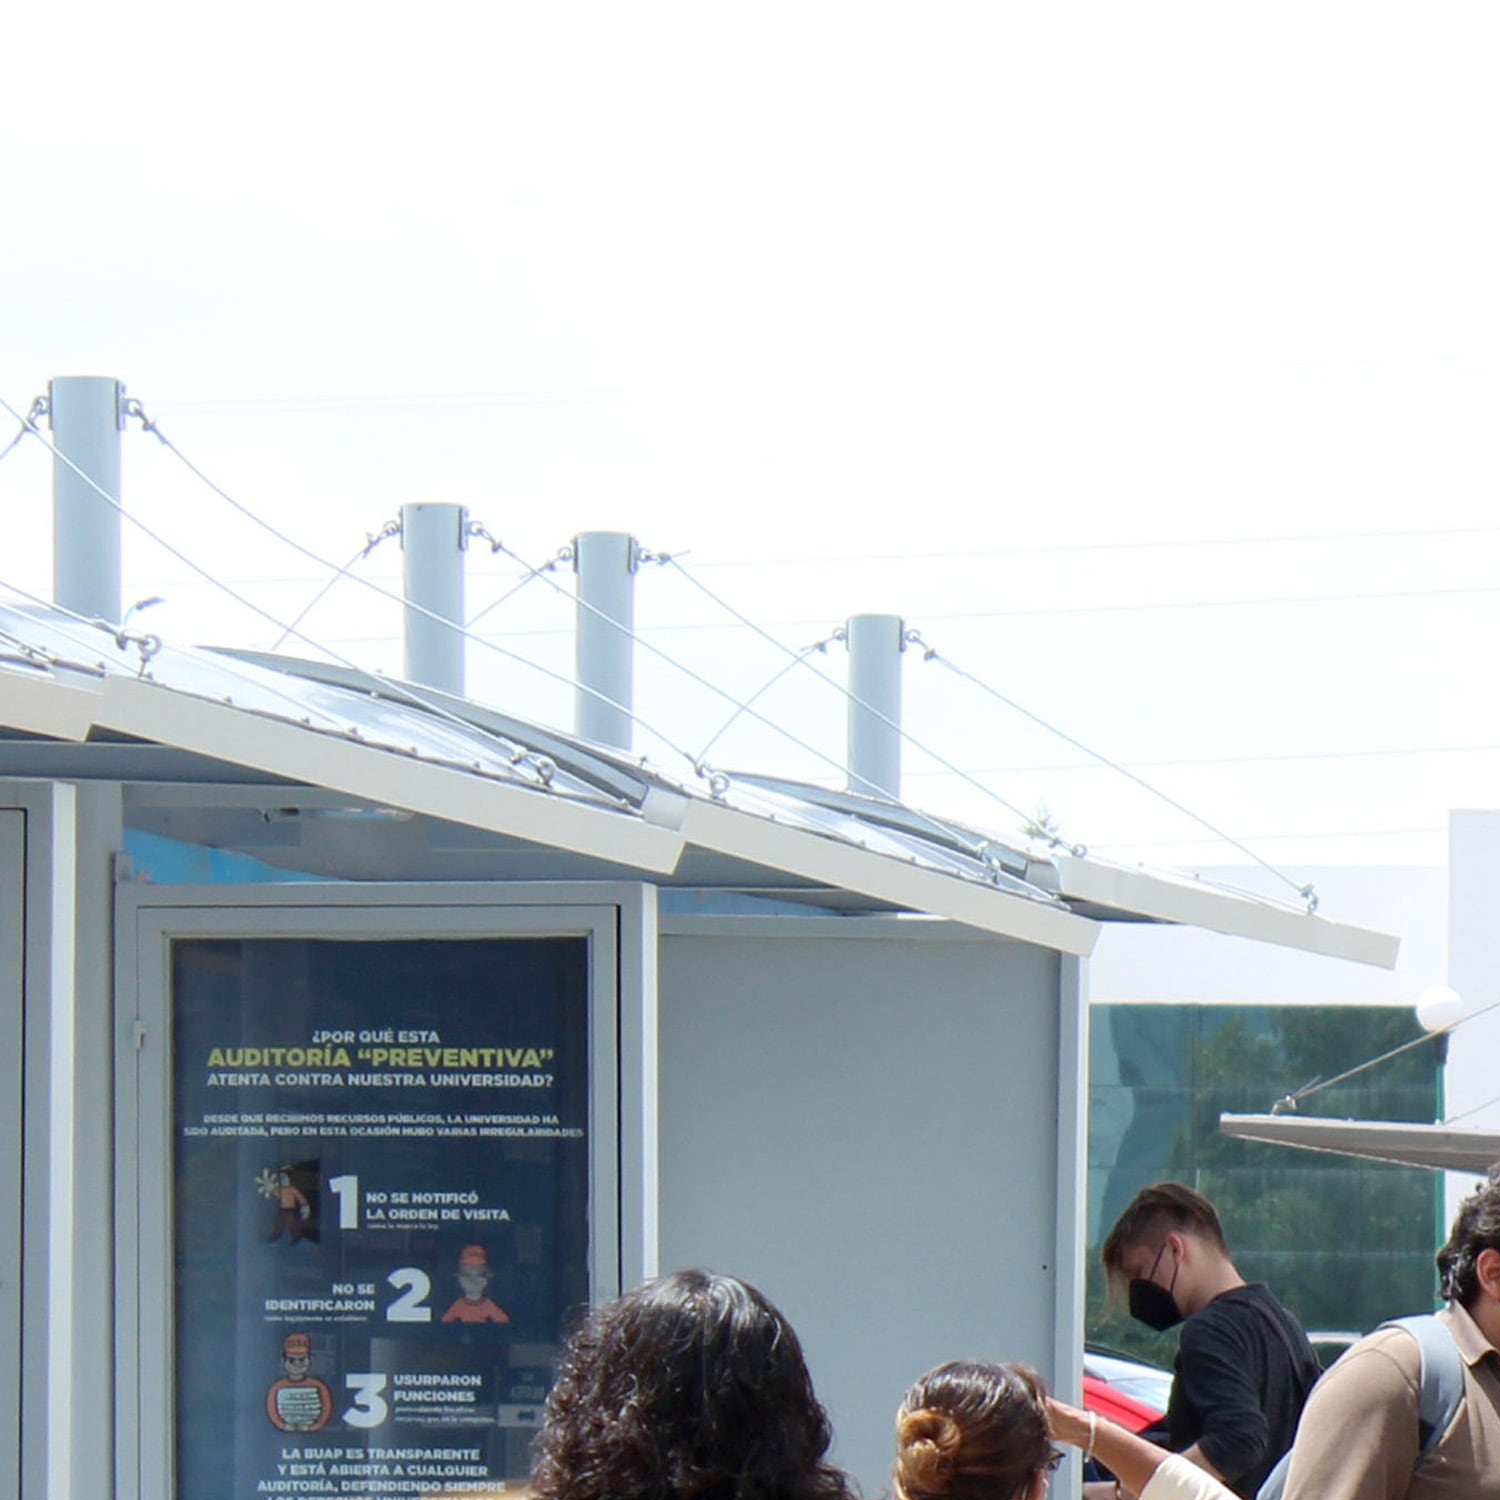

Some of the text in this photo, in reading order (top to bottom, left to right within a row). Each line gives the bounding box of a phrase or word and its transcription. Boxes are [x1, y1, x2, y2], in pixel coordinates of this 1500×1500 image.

[312, 1027, 441, 1043] ¿POR QUÉ ESTA
[207, 1043, 554, 1067] AUDITORÍA “PREVENTIVA”
[207, 1073, 553, 1087] ATENTA CONTRA NUESTRA UNIVERSIDAD?
[203, 1114, 239, 1124] DESDE
[327, 1114, 386, 1124] RECURSOS
[447, 1114, 463, 1124] LA
[464, 1115, 540, 1125] UNIVERSIDAD
[210, 1126, 268, 1137] AUDITADA,
[270, 1126, 300, 1136] PERO
[302, 1127, 317, 1136] EN
[319, 1127, 348, 1136] ESTA
[350, 1125, 400, 1136] OCASIÓN
[436, 1127, 477, 1137] VARIAS
[328, 1175, 358, 1230] 1
[366, 1189, 479, 1204] NO SE NOTIFICÓ
[366, 1209, 510, 1220] LA ORDEN DE VISITA
[332, 1283, 376, 1295] NO SE
[386, 1267, 432, 1322] 2
[265, 1299, 375, 1311] IDENTIFICARON
[394, 1375, 482, 1386] USURPARON
[342, 1373, 388, 1428] 3
[394, 1390, 476, 1403] FUNCIONES
[282, 1448, 480, 1460] LA BUAP ES TRANSPARENTE
[277, 1461, 489, 1476] Y ESTÁ ABIERTA A CUALQUIER
[257, 1478, 506, 1493] AUDITORÍA, DEFENDIENDO SIEMPRE
